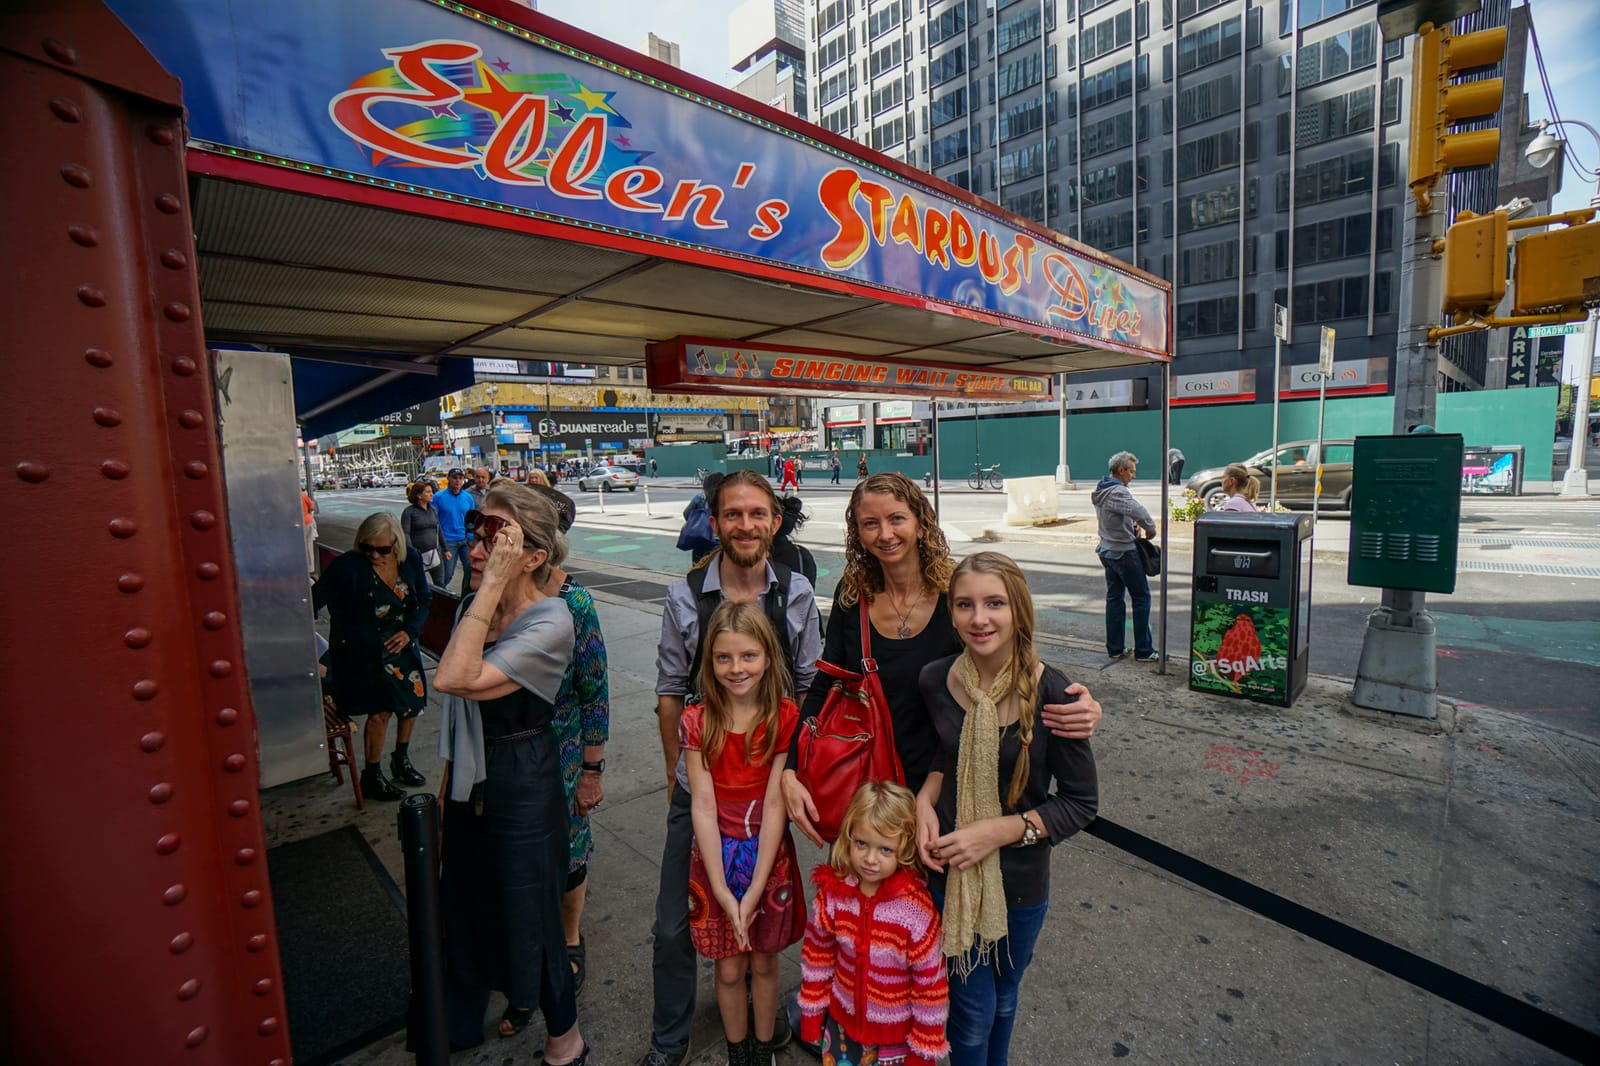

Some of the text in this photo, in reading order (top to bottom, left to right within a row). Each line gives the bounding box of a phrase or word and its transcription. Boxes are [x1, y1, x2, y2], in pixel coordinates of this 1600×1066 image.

[329, 38, 790, 241] Ellen's
[1043, 252, 1142, 337] Diner
[1531, 325, 1574, 338] BROADWAY
[1512, 326, 1527, 368] ARK
[771, 358, 1005, 391] SINGING WAIT STAFF
[1013, 379, 1043, 392] FULL BAR
[406, 412, 413, 423] 9
[1226, 588, 1269, 603] TRASH
[1192, 654, 1287, 676] @TSqArts
